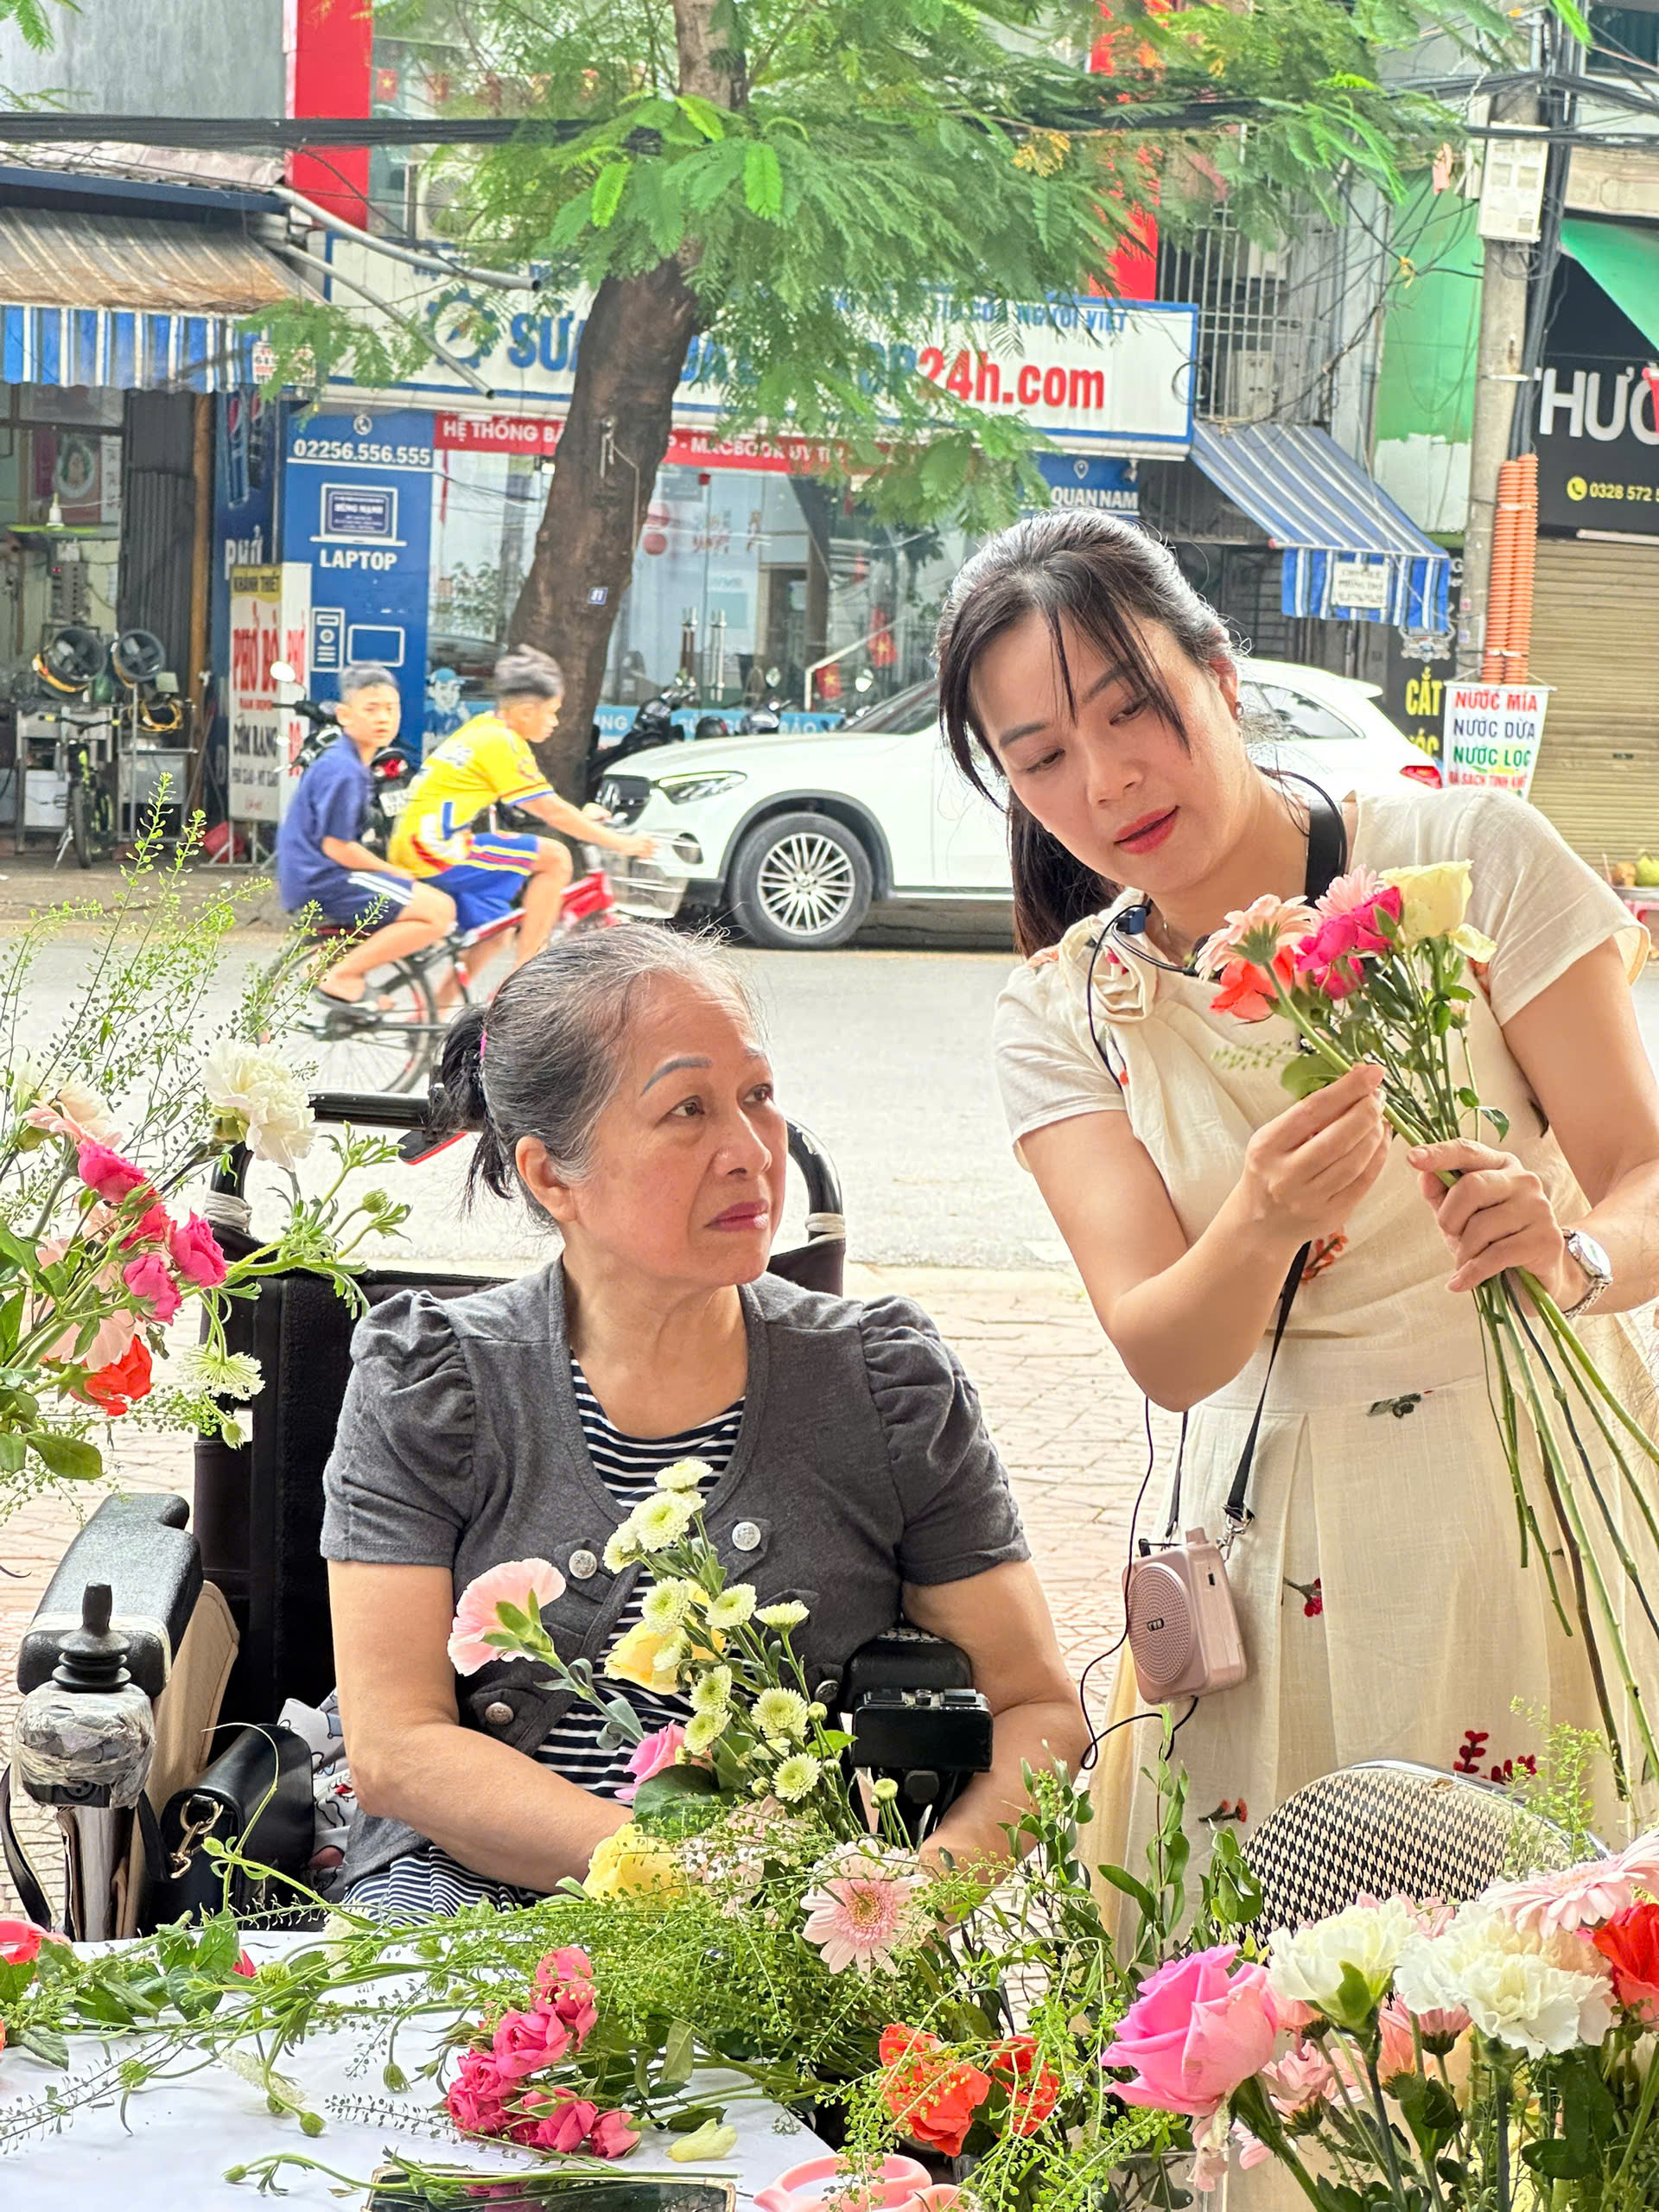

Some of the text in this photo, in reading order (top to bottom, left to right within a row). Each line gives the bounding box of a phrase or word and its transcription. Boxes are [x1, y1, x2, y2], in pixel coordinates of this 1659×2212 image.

[443, 421, 467, 442] HỆ
[472, 418, 539, 442] THỐNG
[294, 438, 431, 466] 02256.556.555
[1589, 481, 1653, 501] 0328 572
[320, 549, 397, 571] LAPTOP
[1405, 665, 1445, 716] CẮT
[1454, 689, 1500, 711] NƯỚC
[1453, 716, 1535, 740] NƯỚC DỪA
[1453, 744, 1498, 766] NƯỚC
